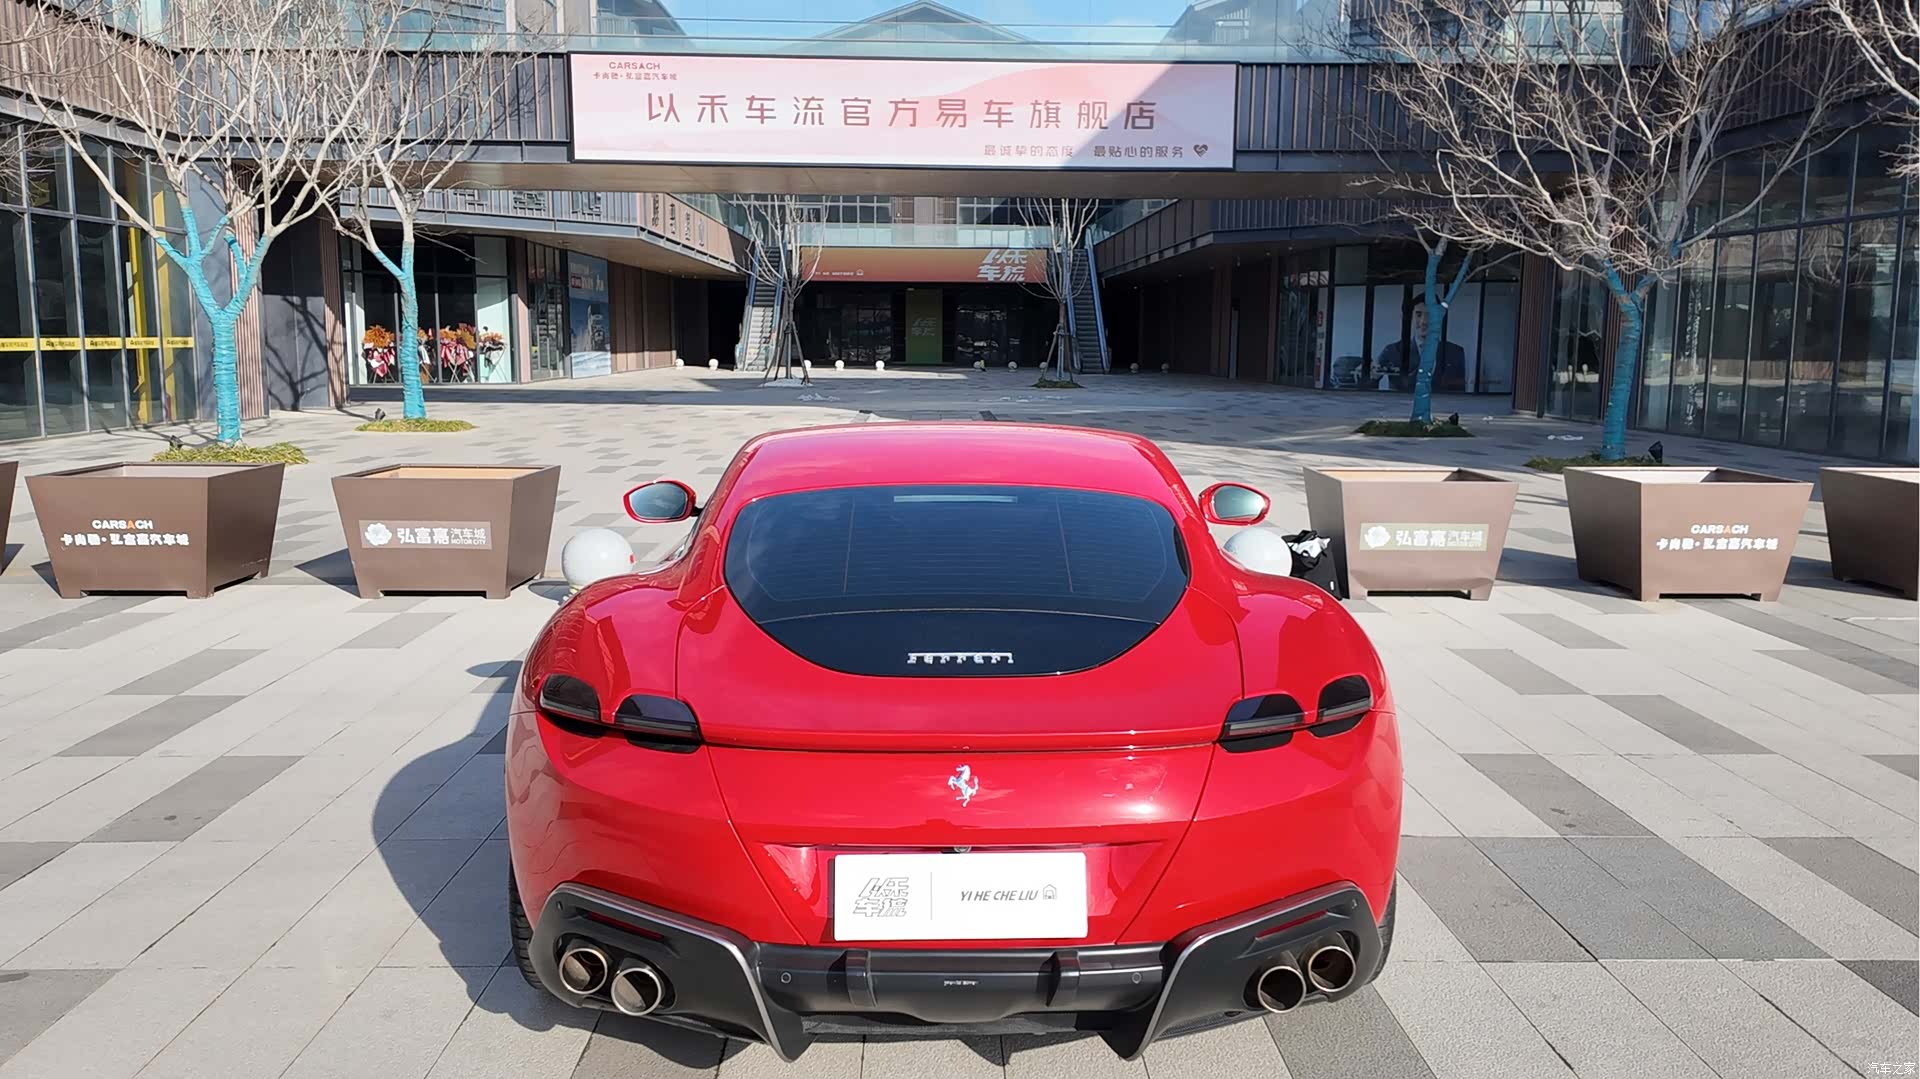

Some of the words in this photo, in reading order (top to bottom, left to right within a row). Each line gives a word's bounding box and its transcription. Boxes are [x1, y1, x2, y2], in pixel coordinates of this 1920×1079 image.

[608, 61, 661, 70] CARSACH
[647, 92, 1156, 130] 以禾车流官方易车旗舰店
[984, 144, 1073, 158] 最诚挚的态度
[1093, 145, 1184, 159] 最贴心的服务
[91, 519, 154, 530] CARSACH
[1690, 524, 1750, 535] CARSACH
[396, 527, 449, 545] 弘富嘉
[450, 527, 486, 539] 汽车城
[1395, 529, 1446, 547] 弘富嘉
[907, 652, 1015, 664] Ferrari
[961, 890, 973, 902] YI
[974, 890, 992, 902] HE
[993, 890, 1018, 901] CHE
[1018, 889, 1039, 901] LIU
